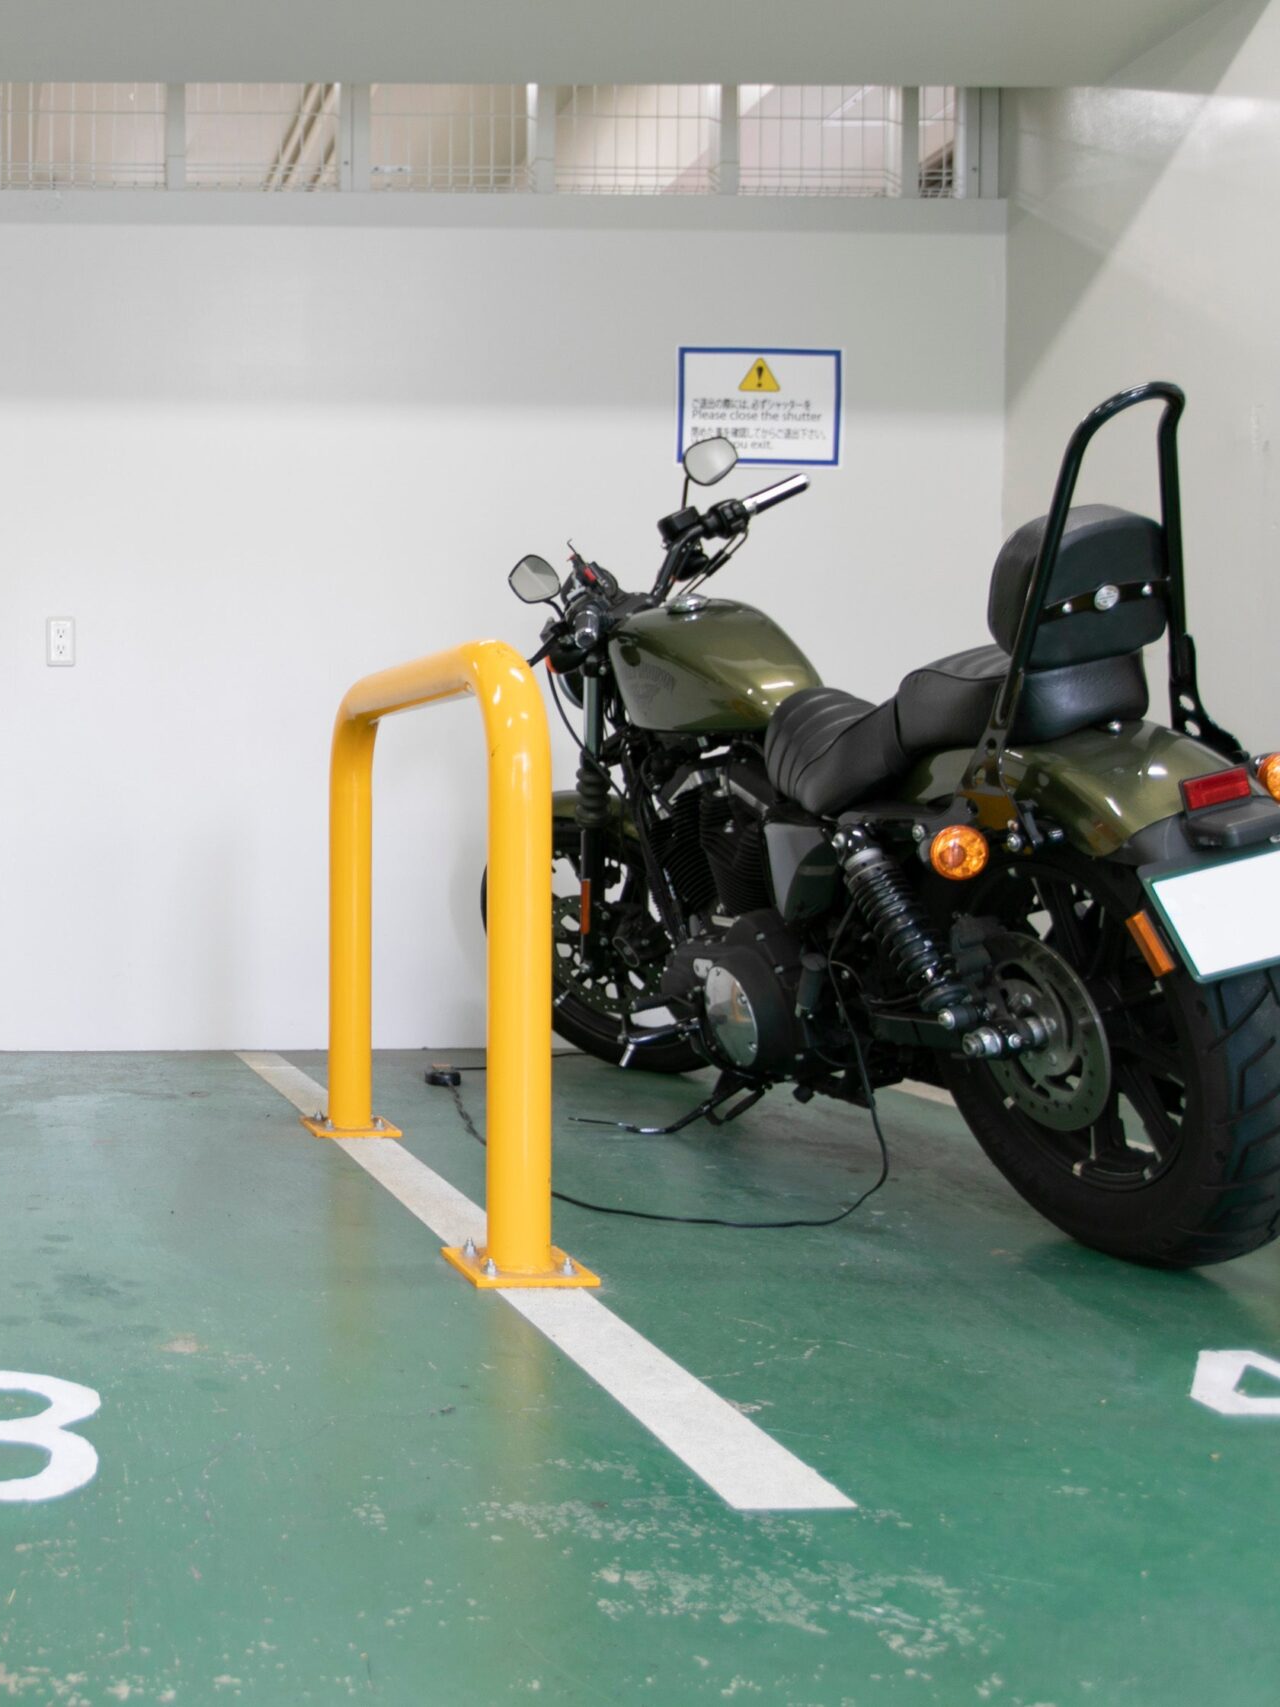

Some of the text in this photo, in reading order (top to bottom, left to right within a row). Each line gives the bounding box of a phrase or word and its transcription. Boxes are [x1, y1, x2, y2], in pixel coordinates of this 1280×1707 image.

[692, 410, 823, 422] Please close the shutter
[751, 439, 773, 450] exit.
